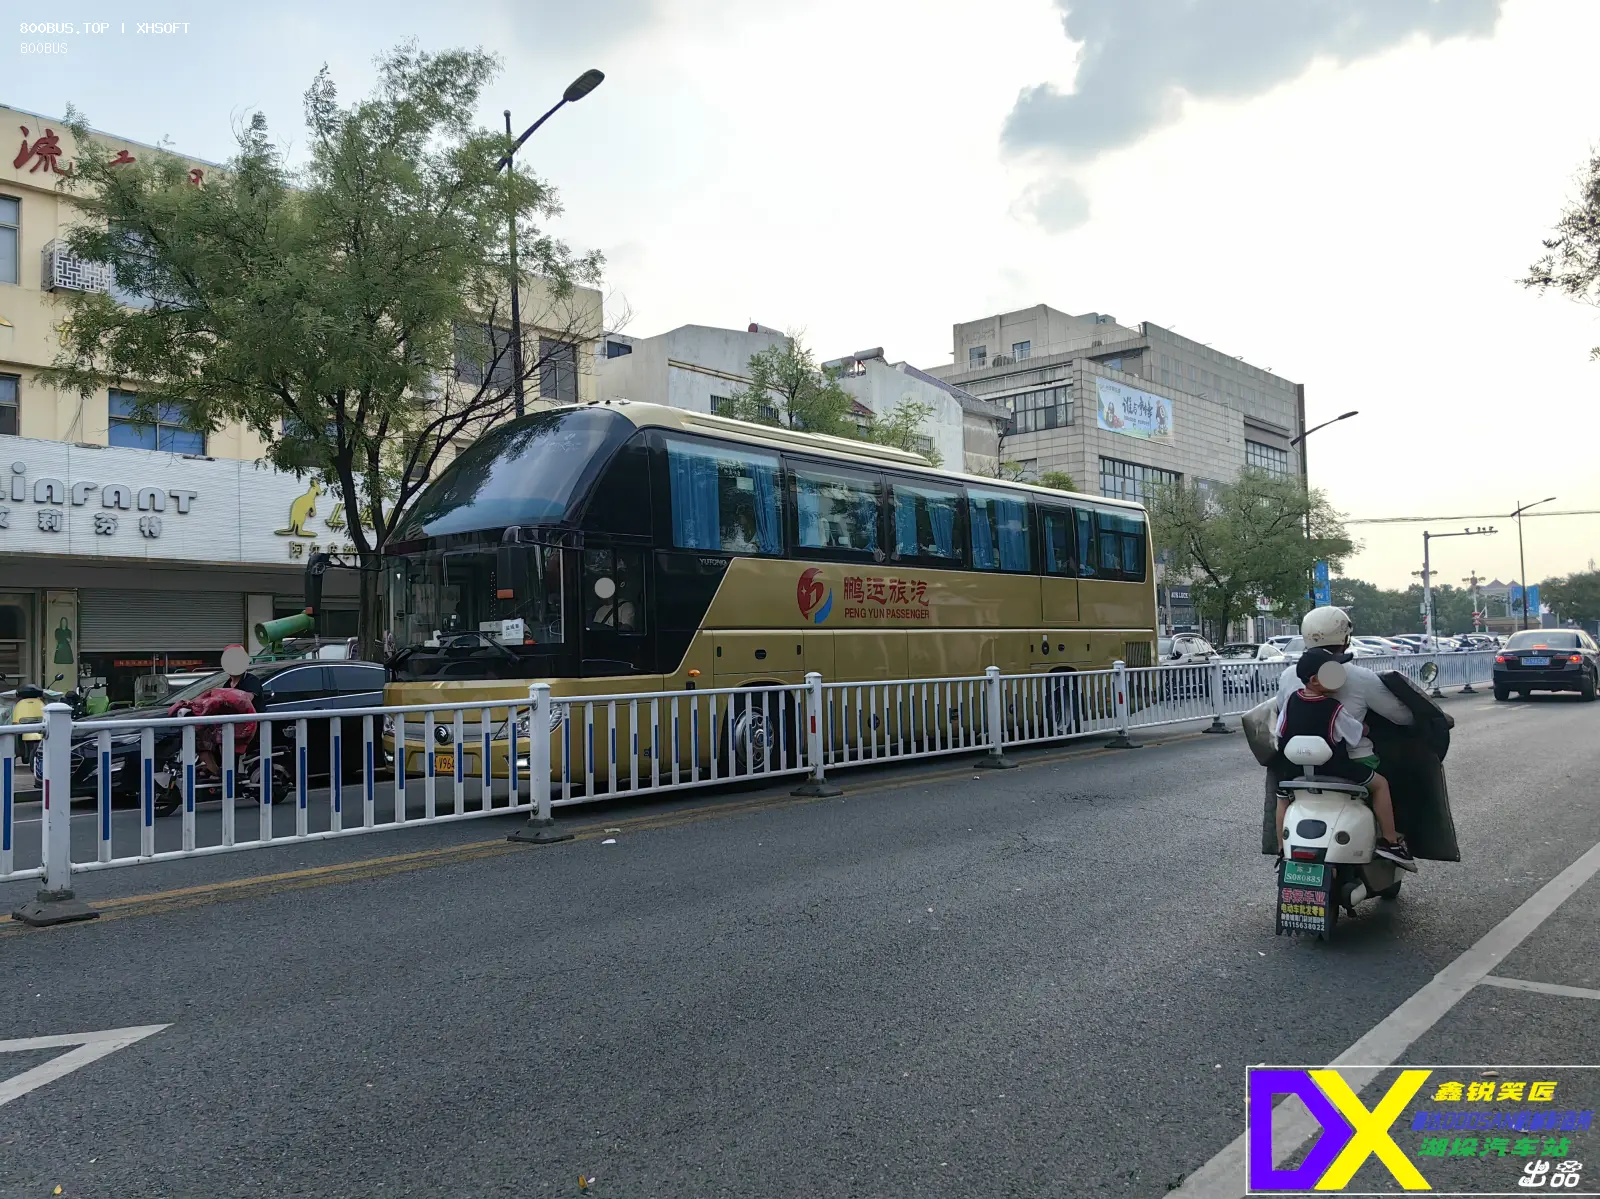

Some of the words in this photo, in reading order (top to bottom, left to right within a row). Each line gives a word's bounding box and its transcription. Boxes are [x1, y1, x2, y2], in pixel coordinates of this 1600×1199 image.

[843, 576, 929, 606] 鹏运旅汽
[844, 607, 867, 619] PENG
[868, 608, 885, 619] YUN
[886, 609, 930, 620] PASSENGER
